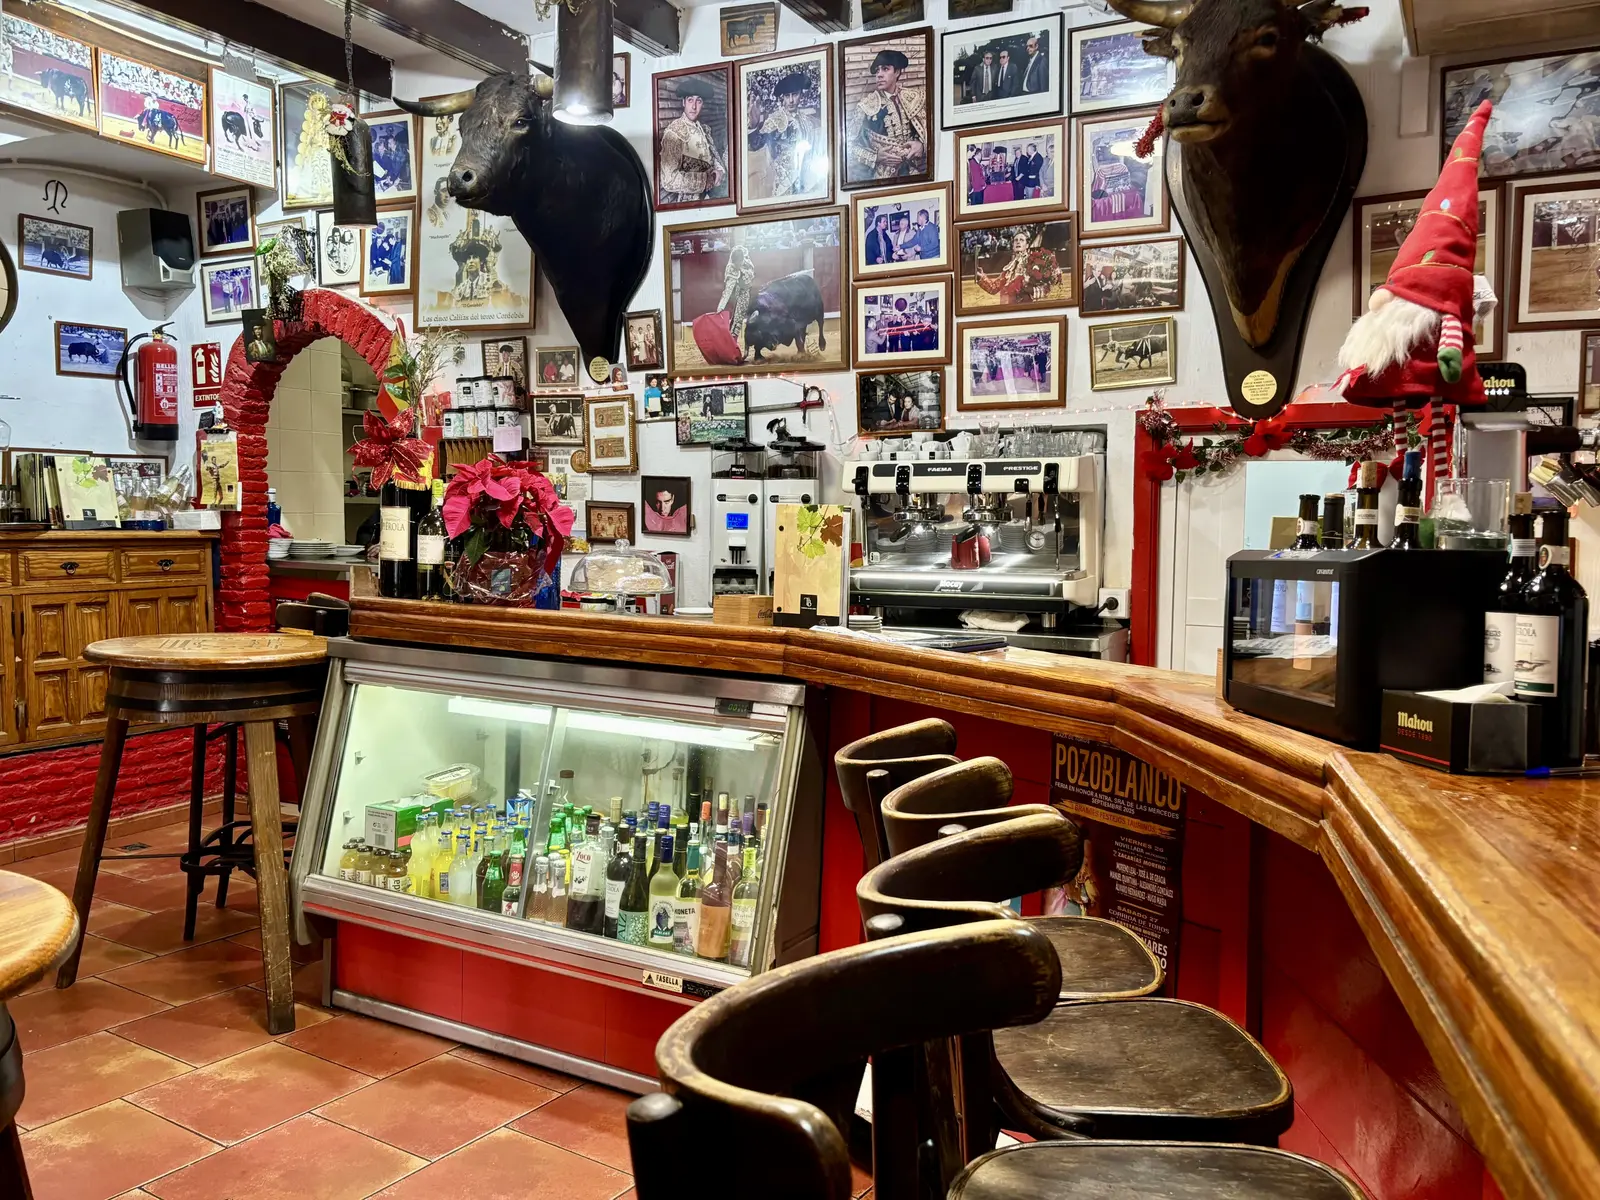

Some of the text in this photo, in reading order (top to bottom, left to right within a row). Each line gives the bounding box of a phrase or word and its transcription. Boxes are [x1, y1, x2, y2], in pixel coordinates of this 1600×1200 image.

[1483, 376, 1515, 388] ahou
[1398, 711, 1433, 732] Mahou
[1056, 743, 1180, 810] POZOBLANCO
[1055, 781, 1068, 790] FERIA
[1076, 786, 1094, 797] HONOR
[1136, 804, 1147, 812] LAS
[1148, 807, 1179, 820] MERCEDES
[1092, 798, 1122, 811] SEPTIEMBRE
[1114, 841, 1144, 854] NOVILLADA
[1120, 836, 1152, 849] VIERNES
[1143, 860, 1166, 871] MORENO
[1109, 908, 1137, 923] CORRIDA
[1148, 923, 1170, 934] TOROS
[656, 974, 679, 986] FASELLA
